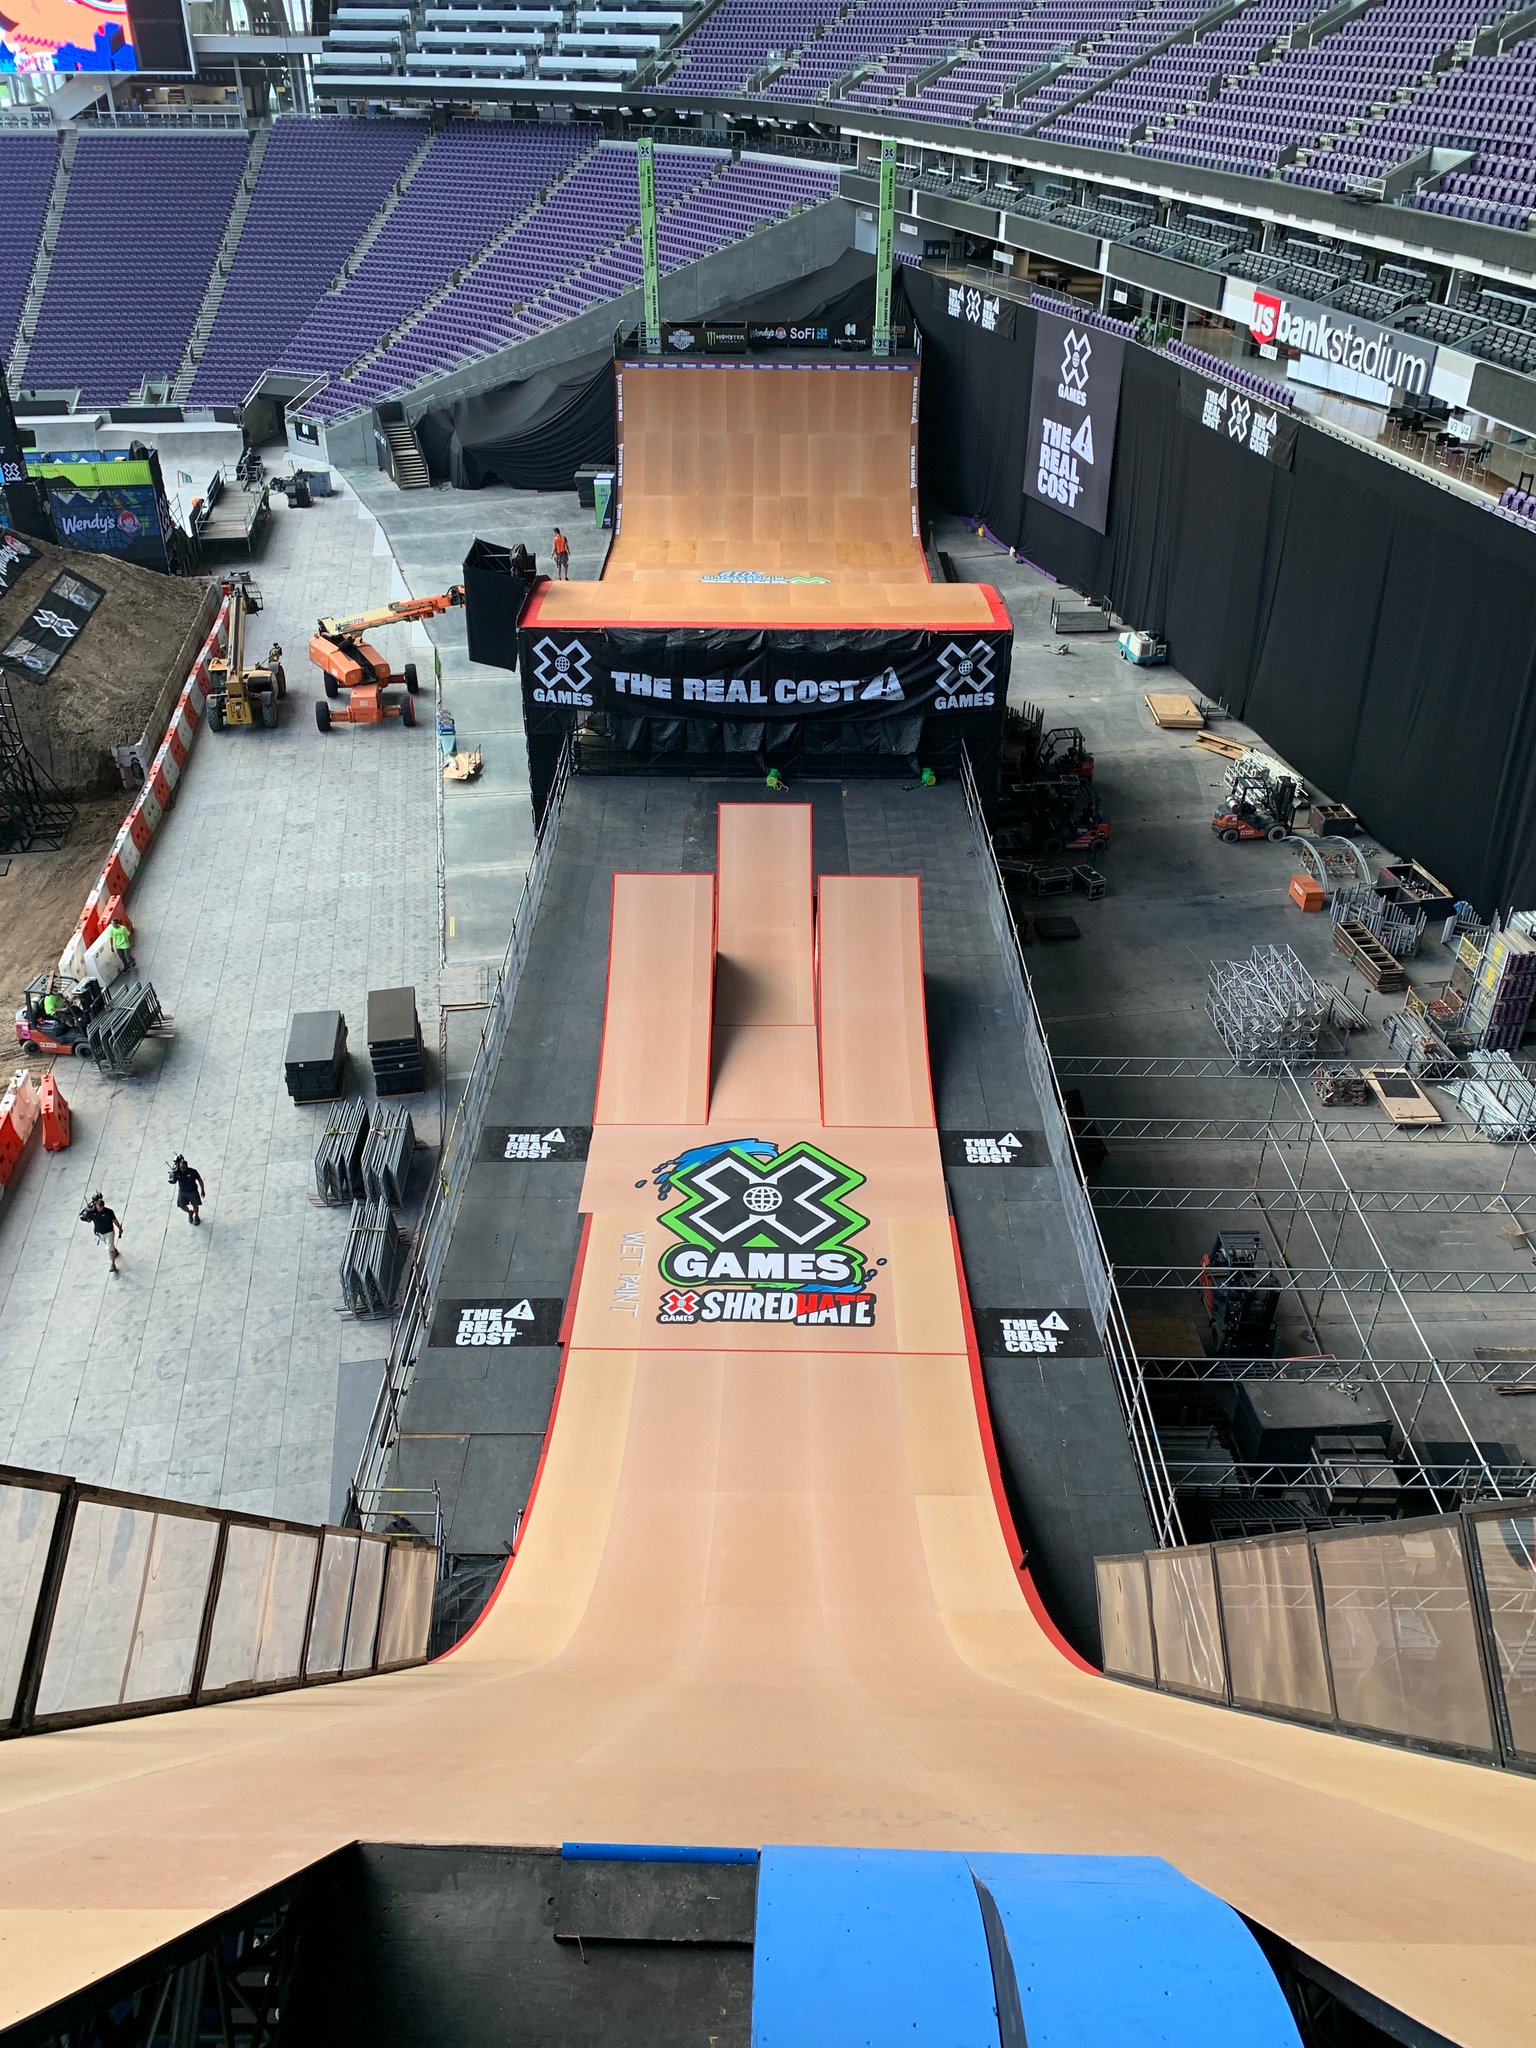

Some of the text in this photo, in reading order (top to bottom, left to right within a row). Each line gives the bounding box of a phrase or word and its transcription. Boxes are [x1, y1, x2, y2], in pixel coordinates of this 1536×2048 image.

[790, 328, 815, 339] SoFi
[1058, 383, 1087, 407] GAMES
[1206, 389, 1219, 401] THE
[1204, 401, 1220, 418] REAL
[1254, 412, 1268, 428] THE
[1042, 418, 1072, 454] THE
[1252, 425, 1270, 444] REAL
[1039, 442, 1080, 485] REAL
[1037, 468, 1079, 508] COST
[62, 513, 115, 535] Wendy's
[611, 671, 860, 704] THE REAL COST
[533, 688, 593, 706] GAMES
[935, 691, 995, 710] GAMES
[508, 1134, 541, 1142] THE
[963, 1138, 997, 1147] THE
[506, 1142, 551, 1150] REAL
[965, 1147, 1011, 1155] REAL
[504, 1150, 549, 1159] COST
[967, 1154, 1012, 1164] COST
[673, 1251, 851, 1280] GAMES
[609, 1231, 647, 1318] WET PAINT
[461, 1308, 503, 1321] THE
[661, 1314, 694, 1323] GAMES
[458, 1321, 517, 1333] REAL
[1000, 1319, 1040, 1330] THE
[456, 1333, 516, 1346] COST
[1002, 1330, 1057, 1341] REAL
[1005, 1340, 1058, 1353] COST
